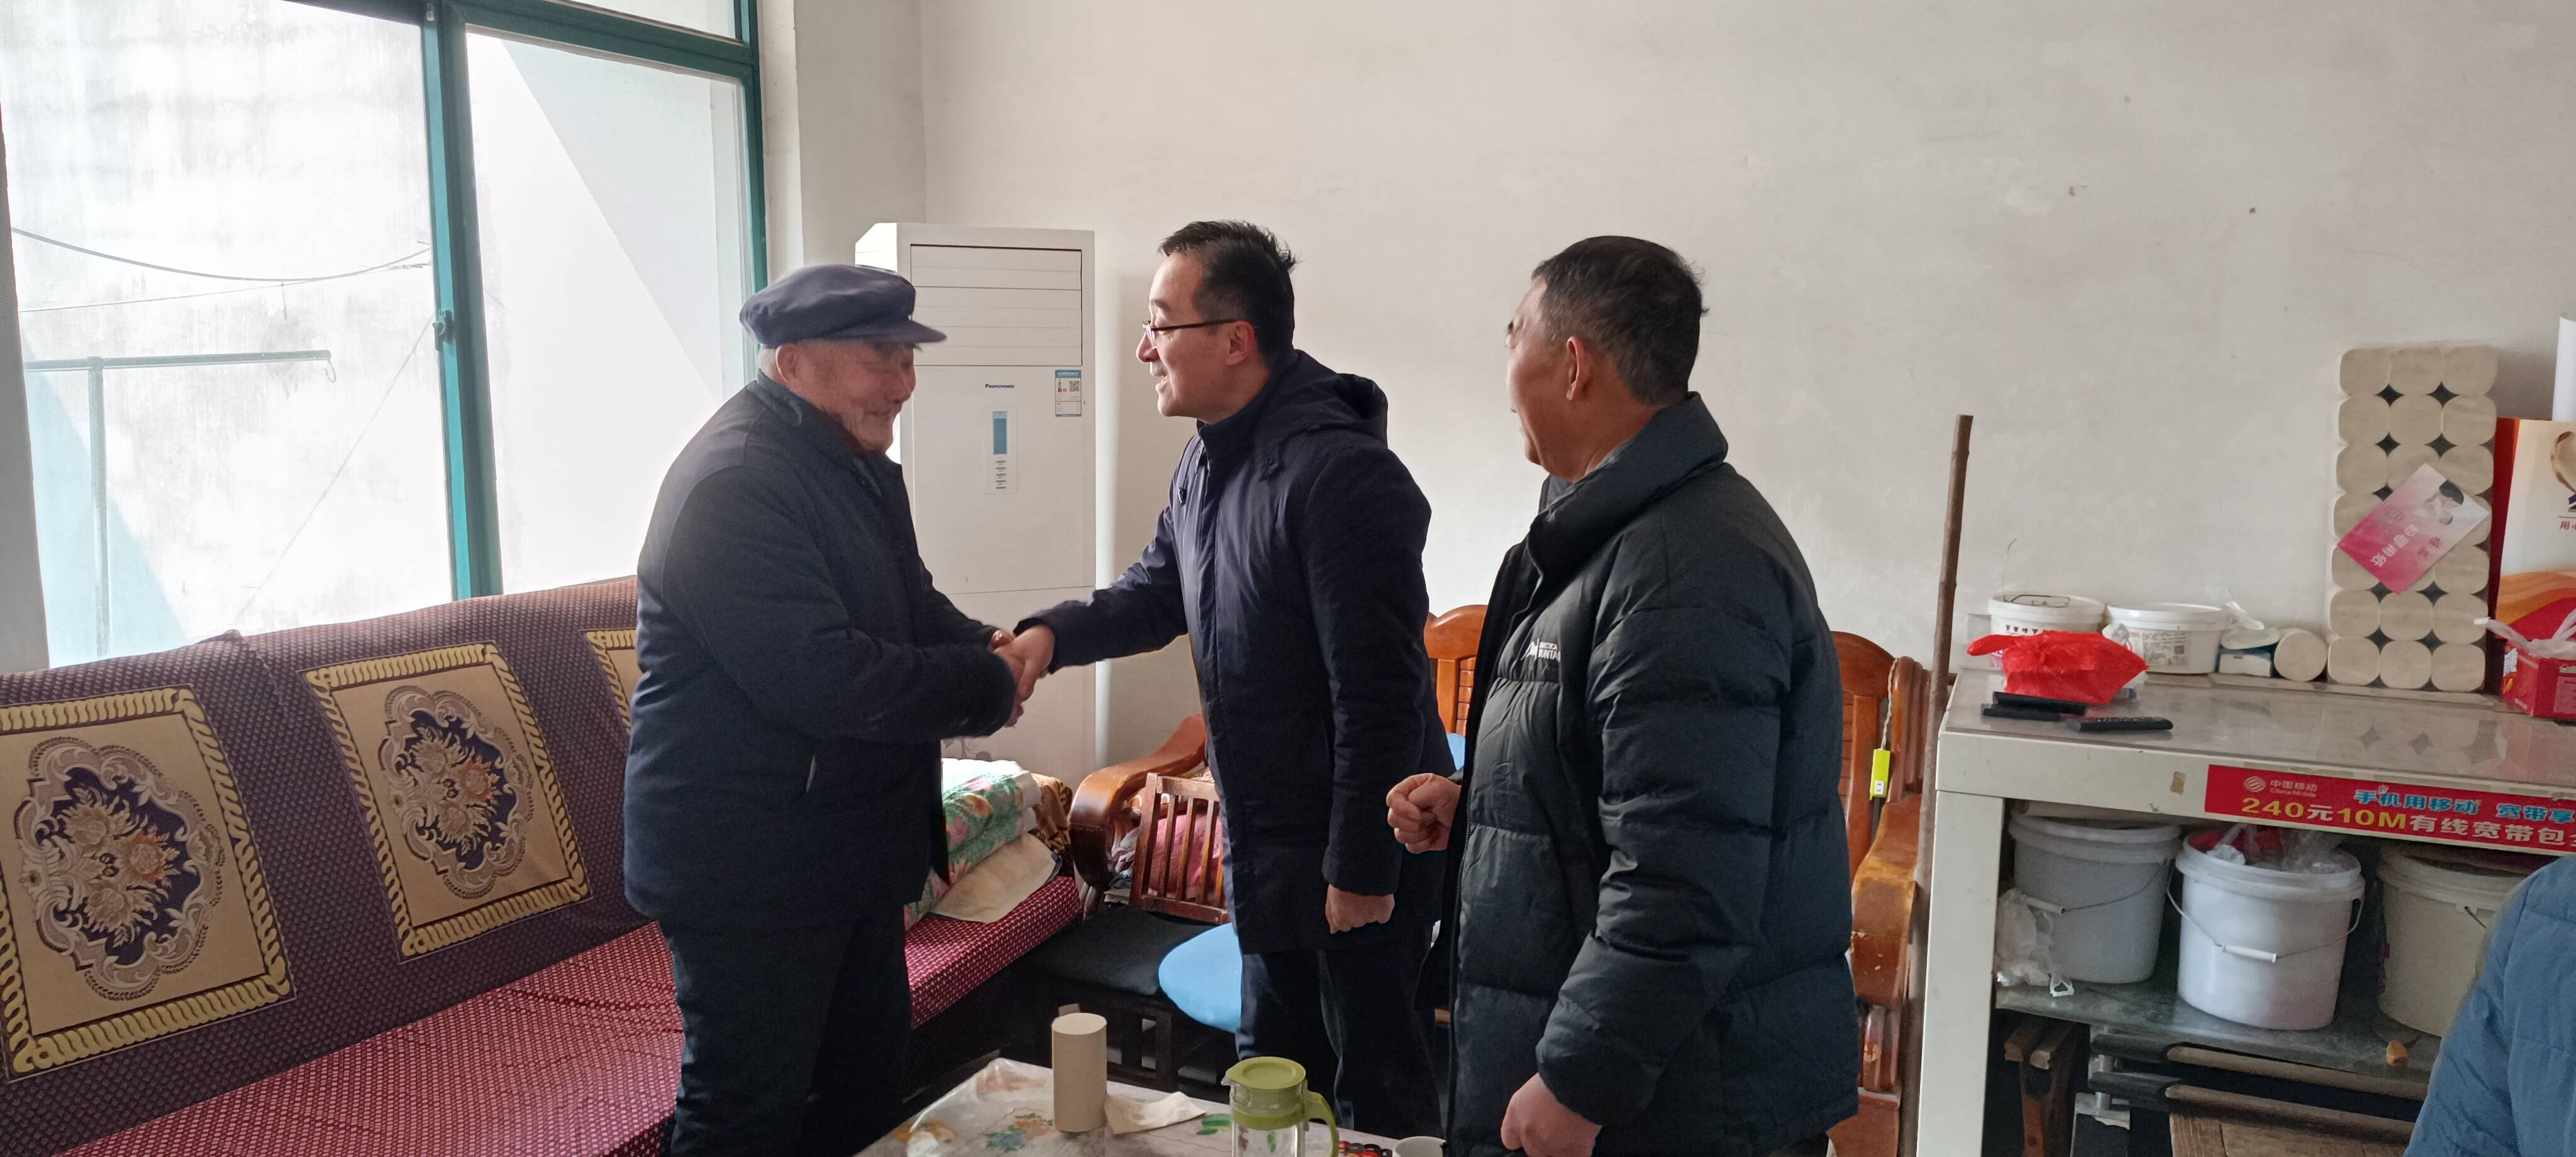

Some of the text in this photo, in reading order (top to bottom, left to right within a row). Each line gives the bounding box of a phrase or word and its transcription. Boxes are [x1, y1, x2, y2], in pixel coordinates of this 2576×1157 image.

[2270, 779, 2318, 792] 中国移动
[2241, 797, 2576, 846] 240元10M有线宽带包
[2353, 788, 2575, 824] 手机用移动 宽带享
